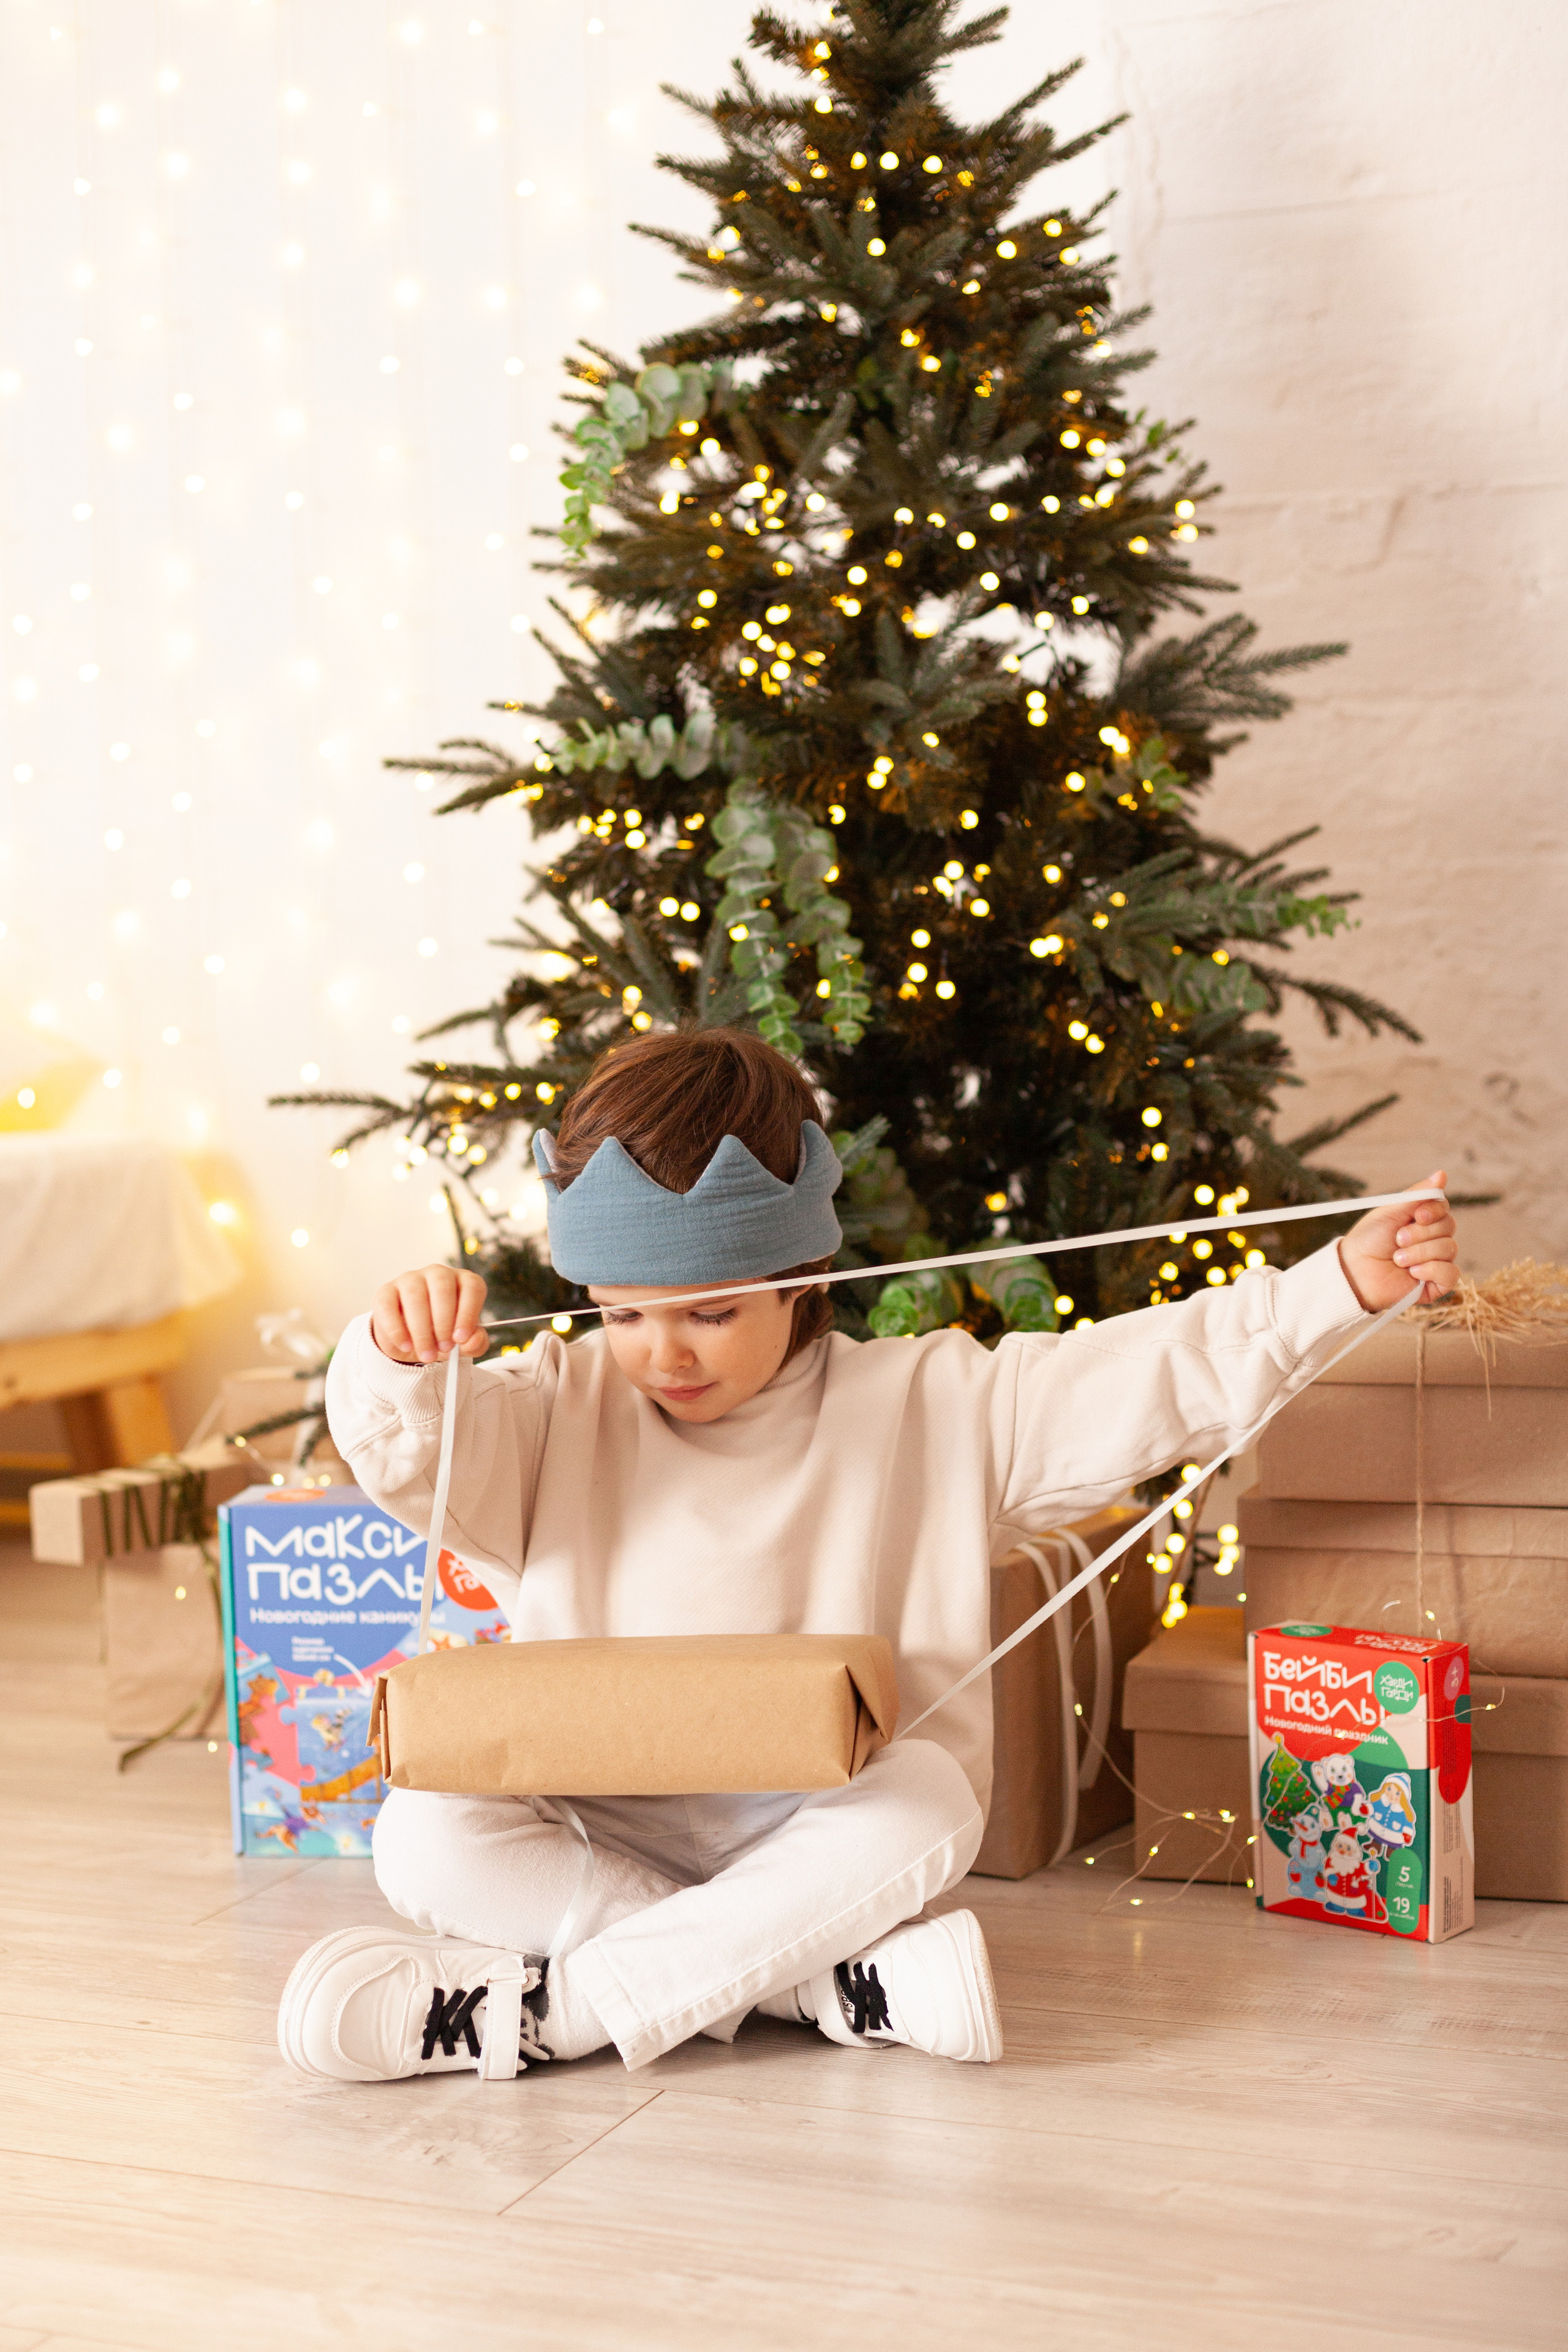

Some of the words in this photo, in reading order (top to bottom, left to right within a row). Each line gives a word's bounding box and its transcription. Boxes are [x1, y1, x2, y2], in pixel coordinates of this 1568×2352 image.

[1264, 1716, 1332, 1736] Новогодний
[1398, 1866, 1411, 1883] 5
[1393, 1896, 1411, 1913] 19
